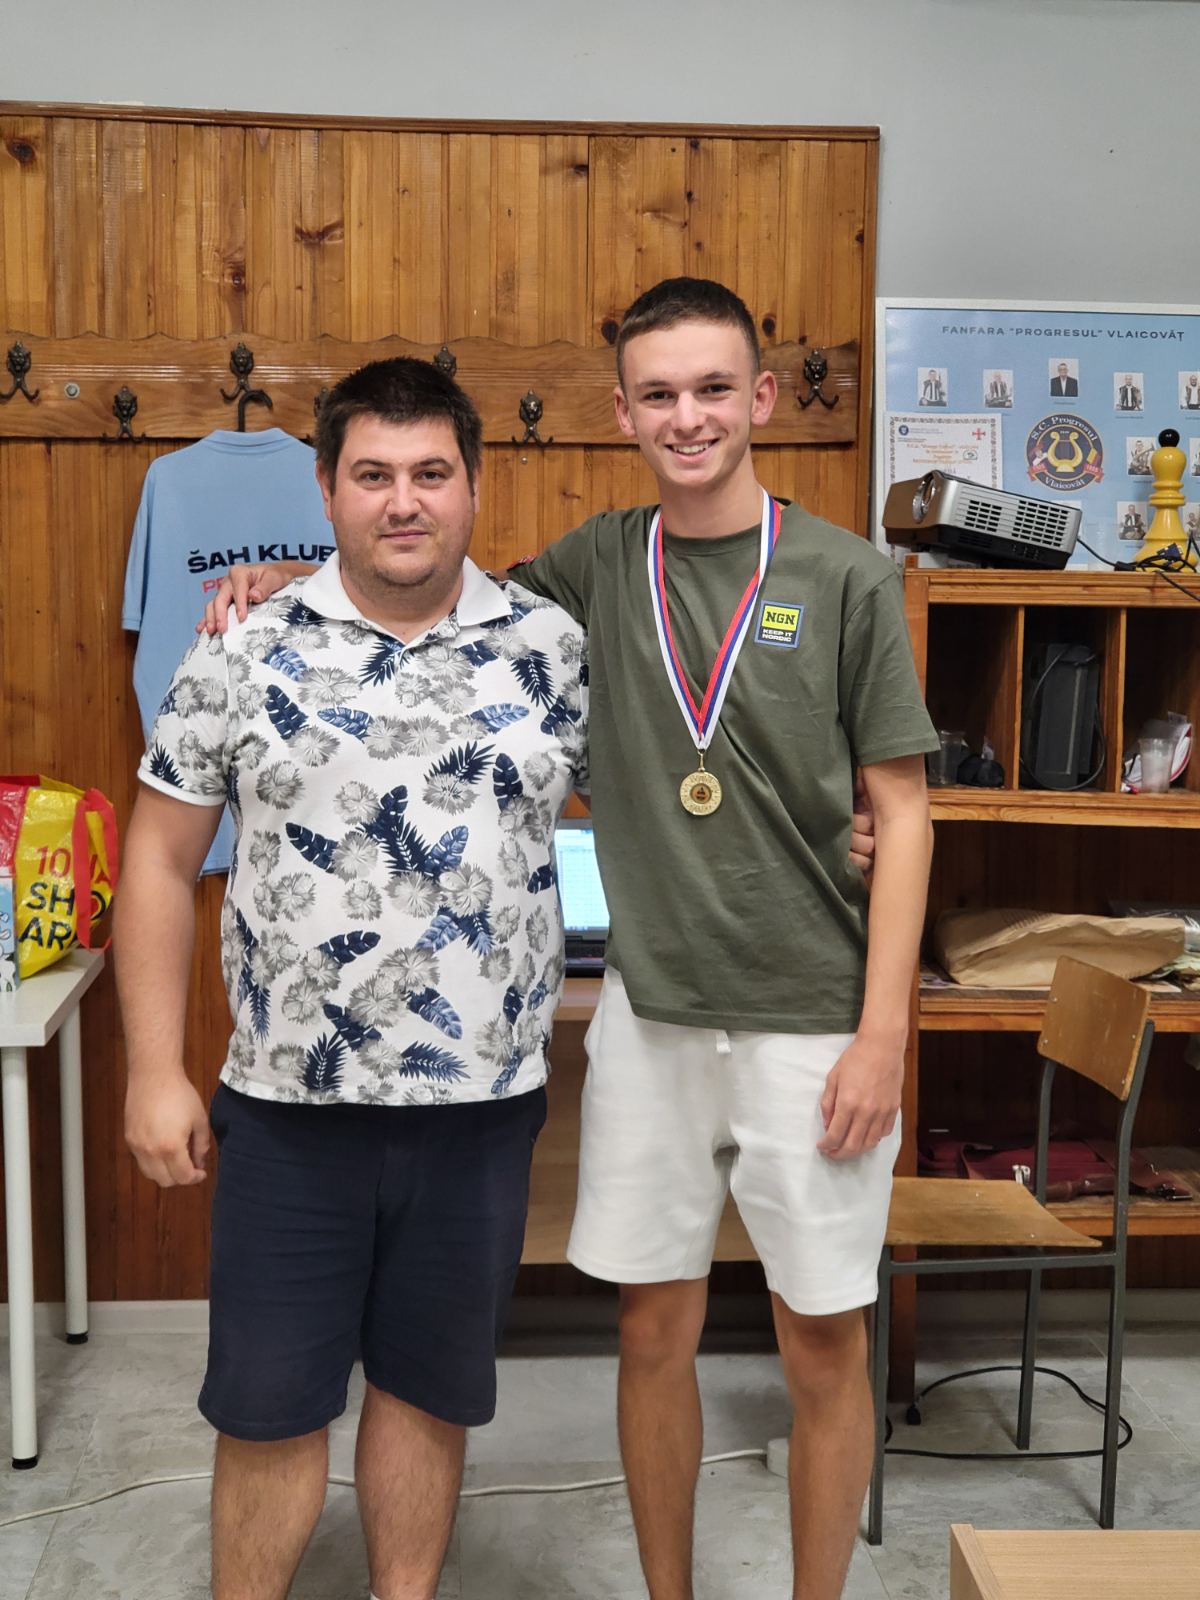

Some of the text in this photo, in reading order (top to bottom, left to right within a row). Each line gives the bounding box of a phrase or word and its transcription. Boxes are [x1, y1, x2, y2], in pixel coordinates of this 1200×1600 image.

[942, 325, 1005, 337] FANFARA
[1051, 416, 1098, 441] Progresul
[187, 546, 251, 574] ŠAH
[765, 611, 796, 625] NGN
[762, 634, 792, 642] NORDIC
